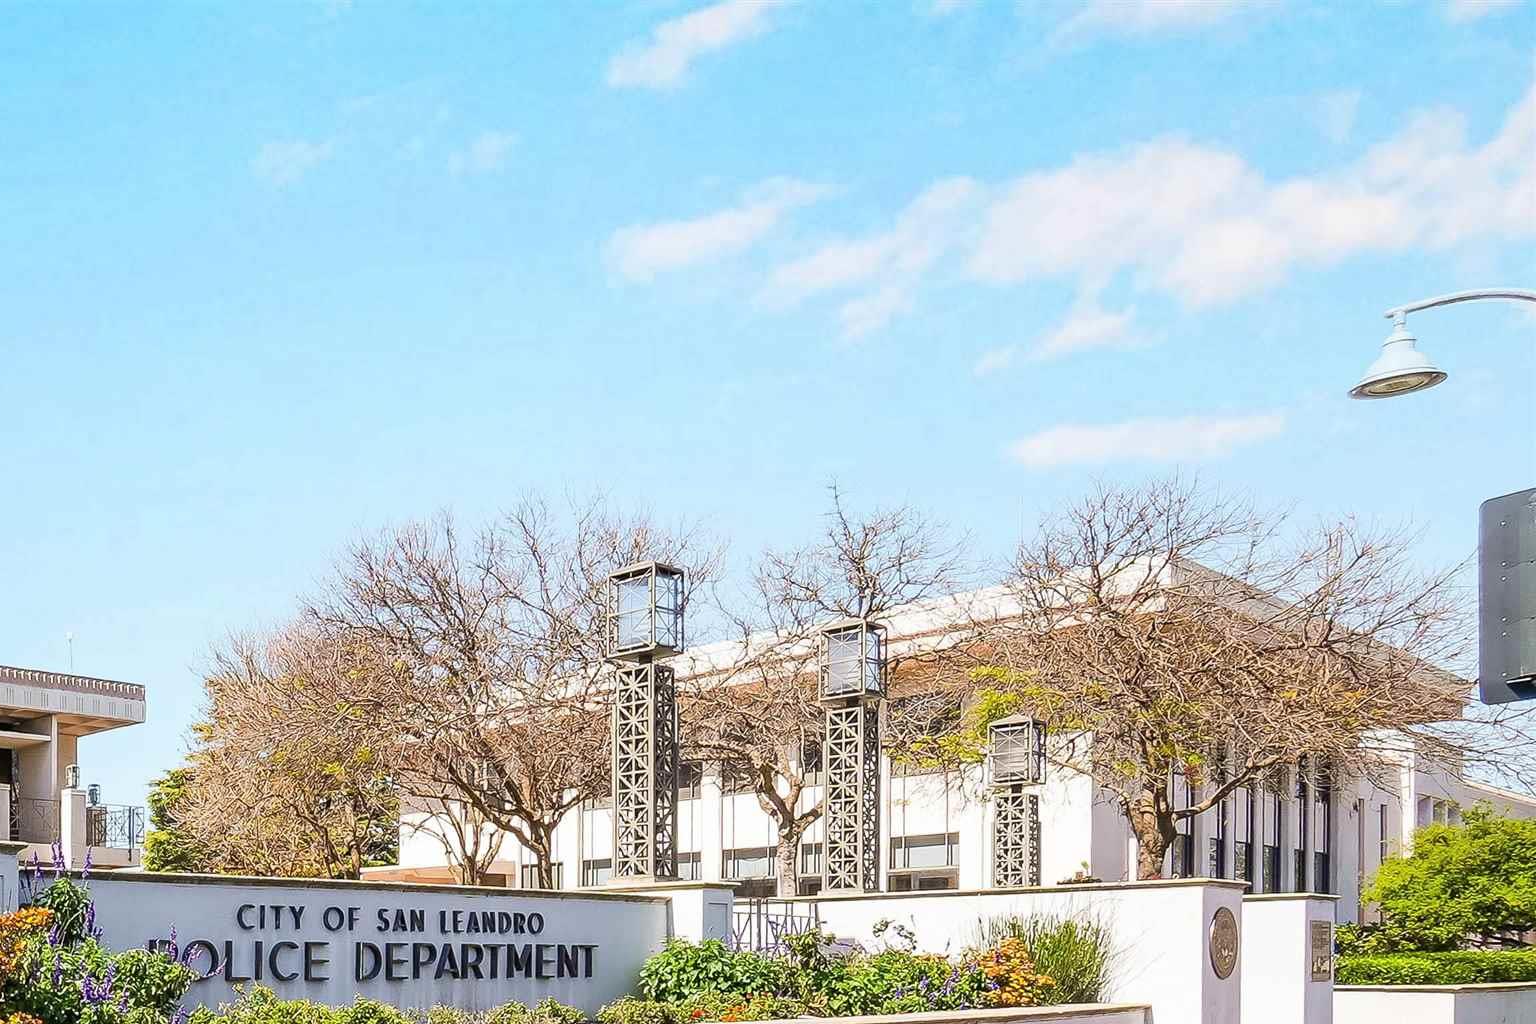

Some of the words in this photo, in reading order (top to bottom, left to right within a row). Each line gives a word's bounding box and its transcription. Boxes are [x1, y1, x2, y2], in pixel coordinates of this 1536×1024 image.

[236, 903, 305, 931] CITY
[322, 906, 362, 933] OF
[377, 908, 425, 933] SAN
[439, 910, 545, 935] LEANDRO
[354, 942, 600, 983] DEPARTMENT
